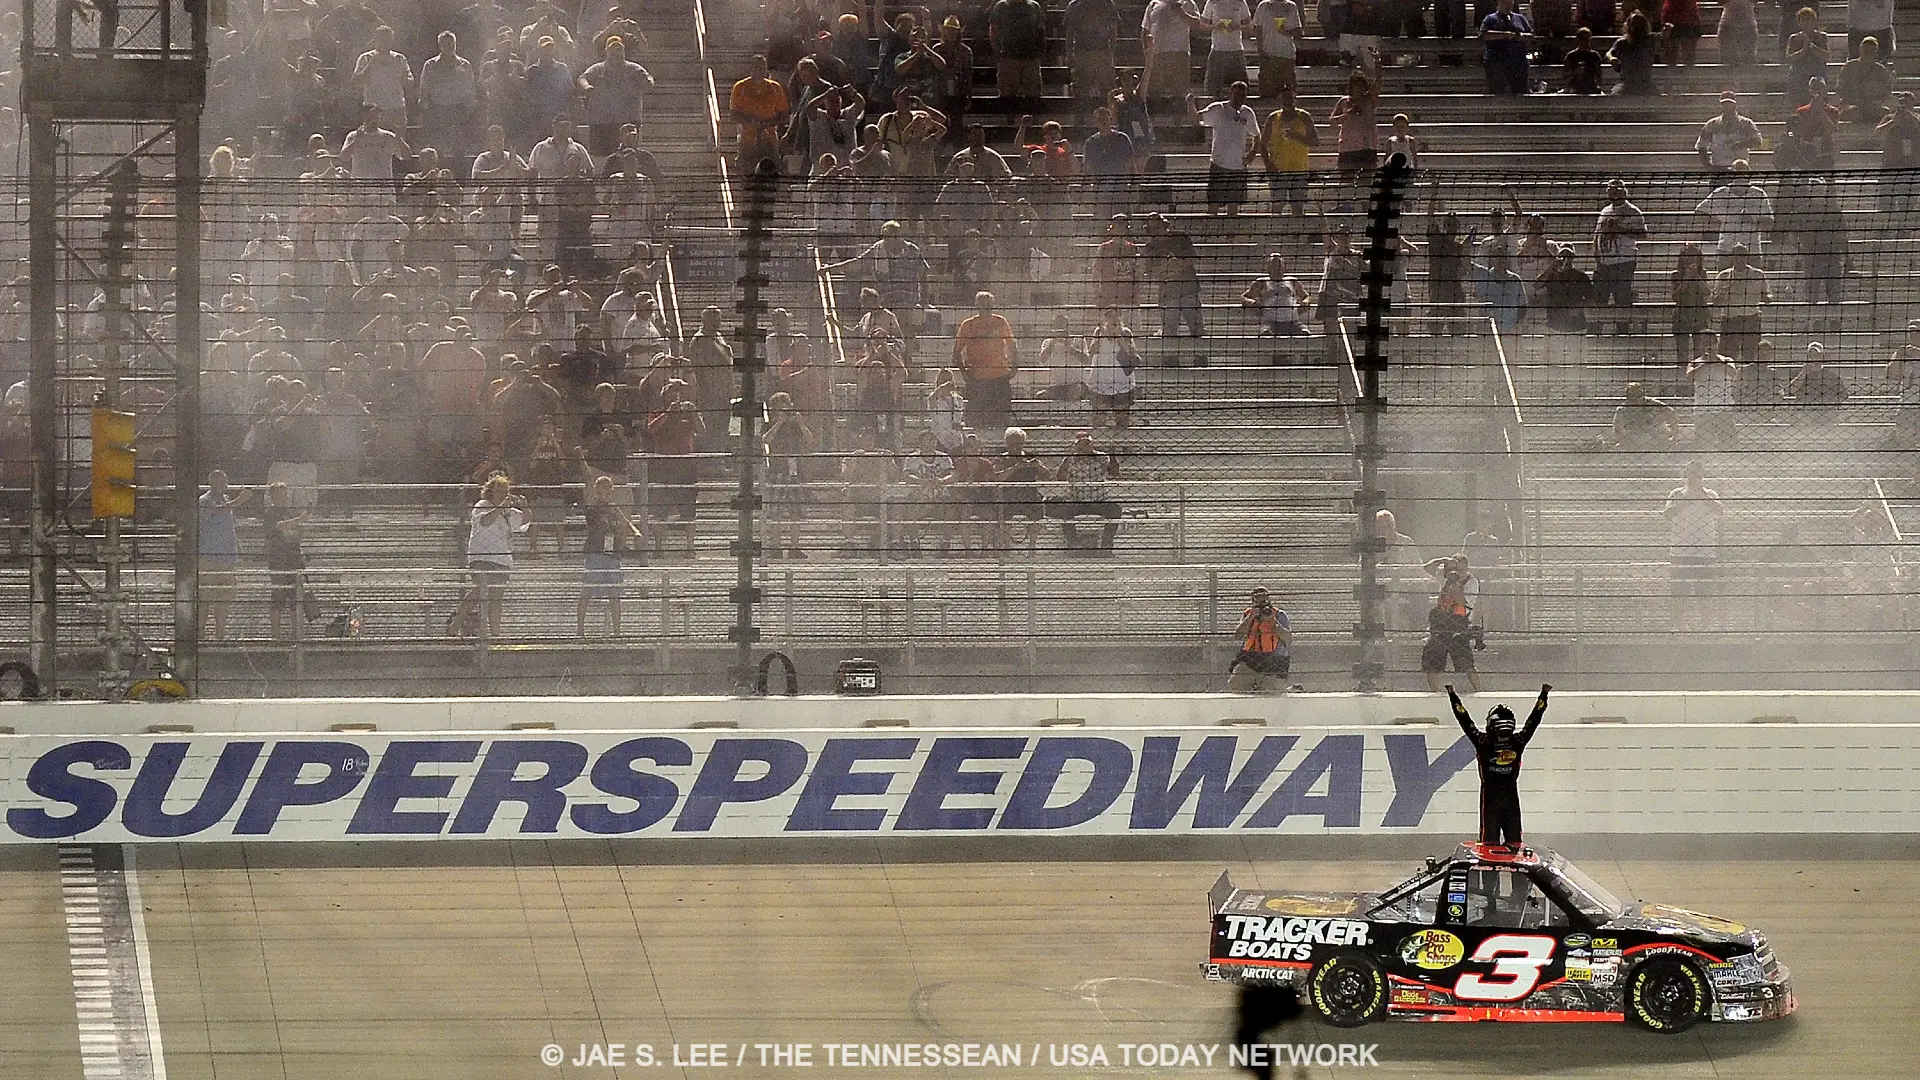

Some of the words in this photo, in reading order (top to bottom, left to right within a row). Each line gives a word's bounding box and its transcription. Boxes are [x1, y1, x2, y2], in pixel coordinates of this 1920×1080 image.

[342, 758, 354, 771] 18
[7, 734, 1476, 838] SUPERSPEEDWAY
[1425, 931, 1451, 943] Bass
[1229, 940, 1313, 961] BOATS
[1425, 942, 1445, 954] Pro
[1426, 952, 1457, 966] Shops
[1241, 967, 1276, 979] ARCTIC
[1277, 969, 1295, 980] CAT
[1453, 934, 1557, 1001] 3
[1593, 974, 1615, 983] MSD
[1761, 986, 1774, 1000] 3
